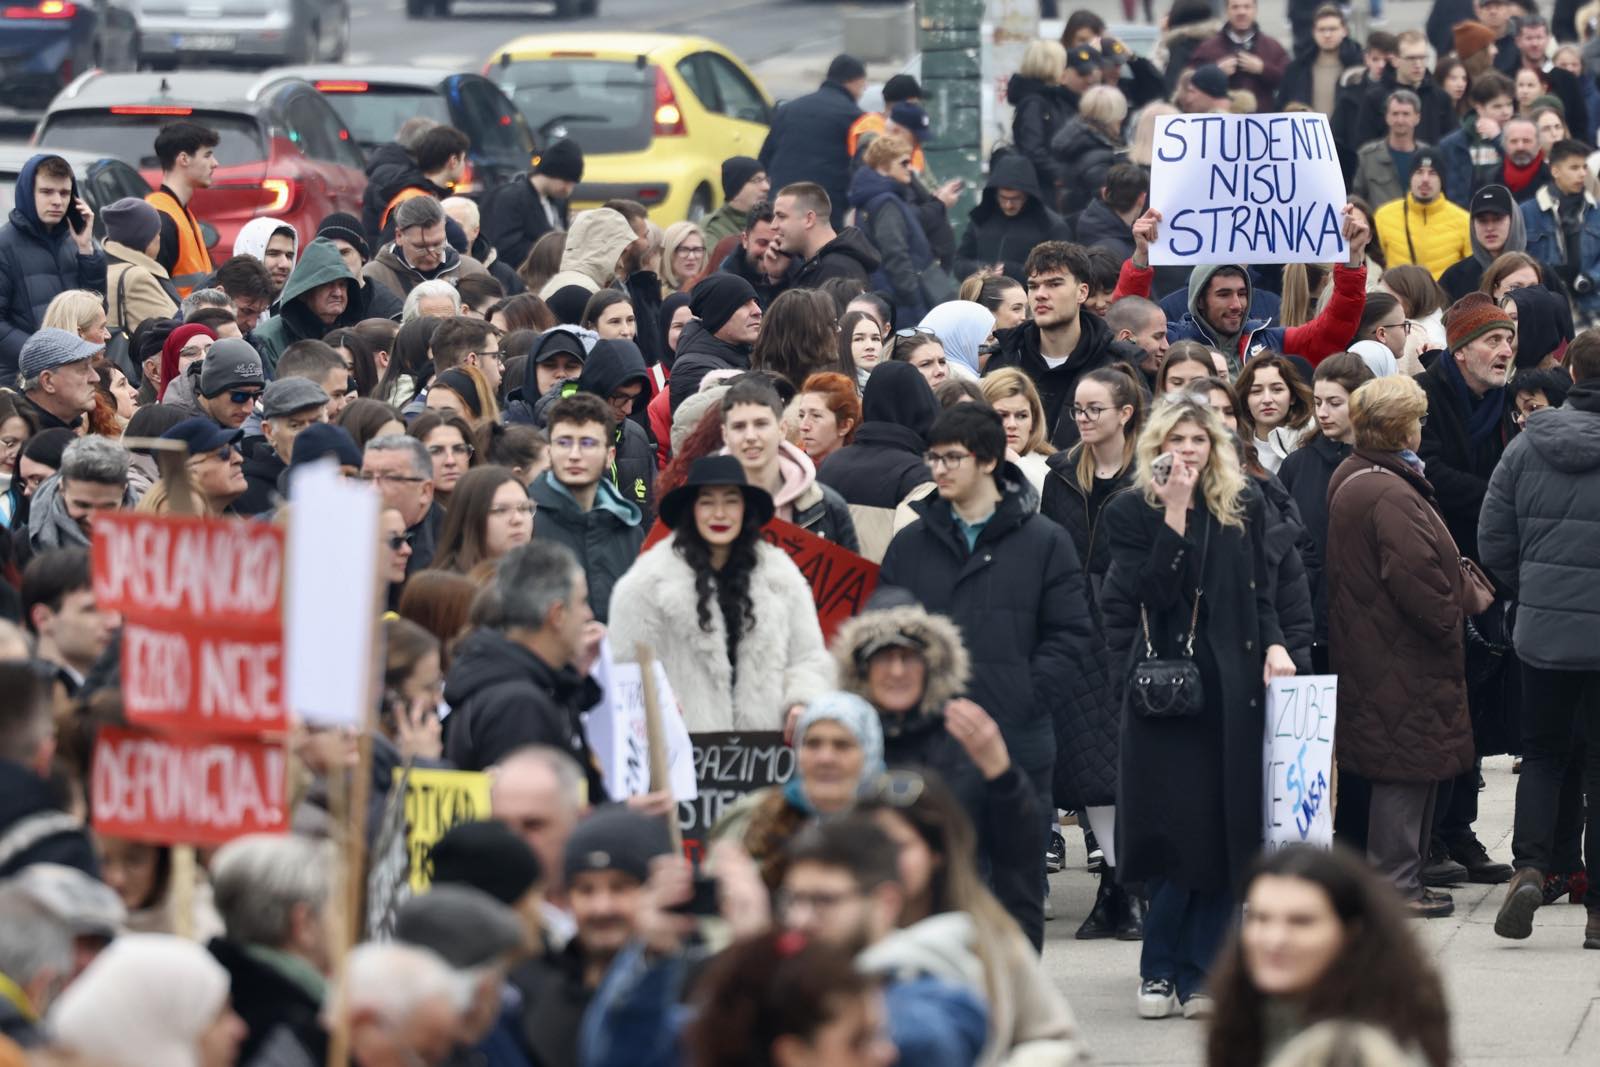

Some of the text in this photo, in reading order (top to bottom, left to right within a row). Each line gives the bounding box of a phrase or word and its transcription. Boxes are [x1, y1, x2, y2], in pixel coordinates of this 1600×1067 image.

[1158, 117, 1333, 162] STUDENTI
[1210, 162, 1296, 204] NISU
[1169, 201, 1344, 256] STRANKA
